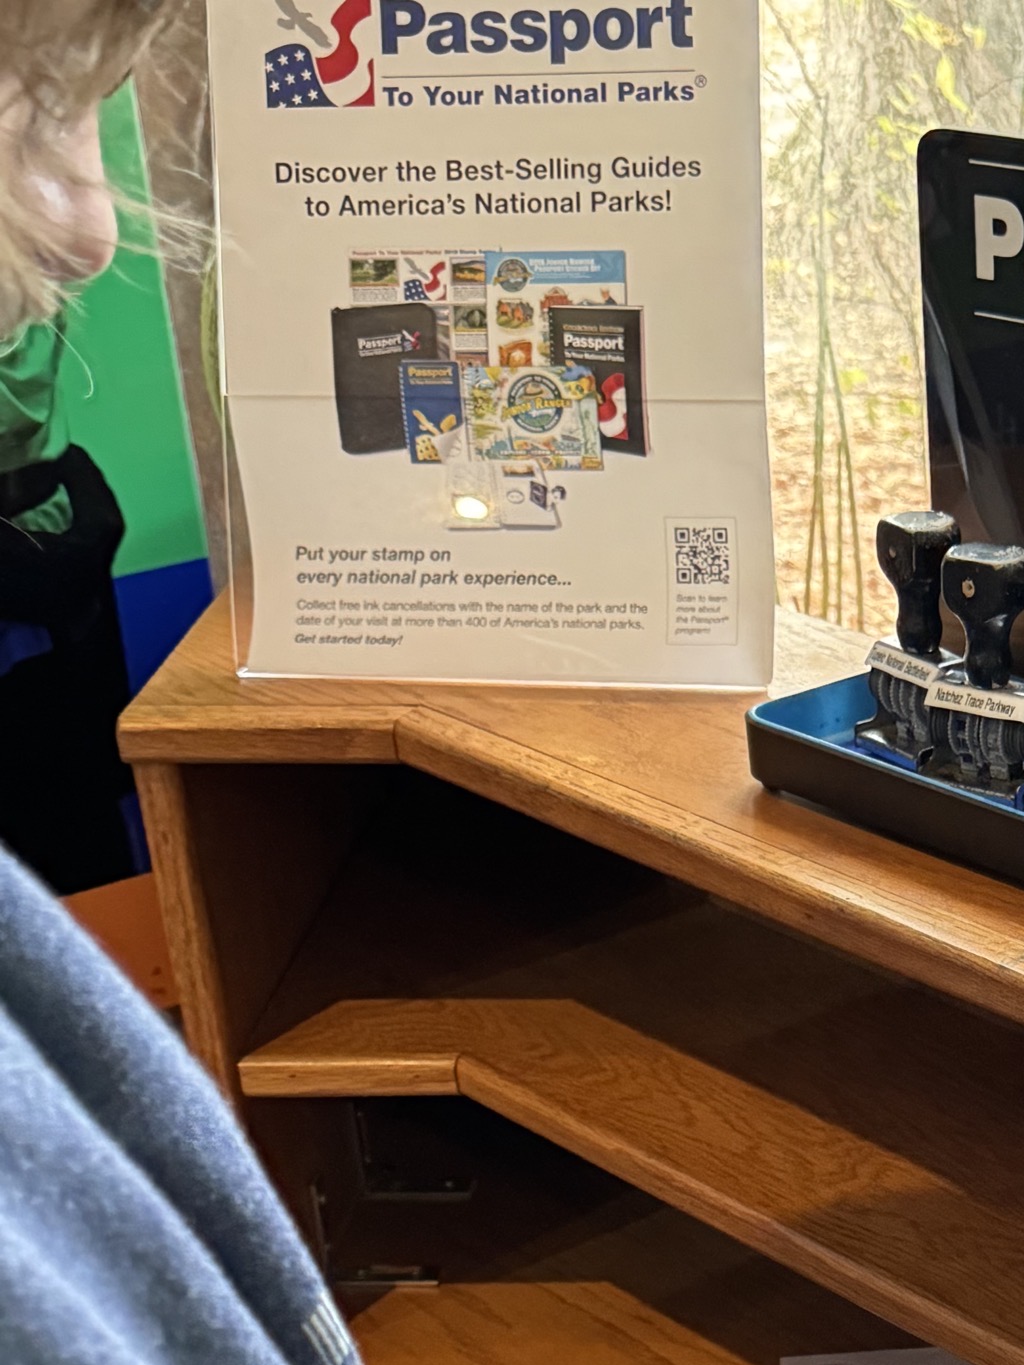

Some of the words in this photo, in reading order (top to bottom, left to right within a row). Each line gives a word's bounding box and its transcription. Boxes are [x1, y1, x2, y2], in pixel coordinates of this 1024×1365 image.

[380, 0, 694, 64] Passport
[383, 87, 413, 107] To
[423, 86, 484, 106] Your
[494, 82, 607, 105] National
[275, 161, 387, 184] Discover
[396, 161, 436, 182] the
[446, 158, 602, 184] Best-Selling
[611, 156, 702, 179] Guides
[305, 196, 329, 216] to
[339, 194, 465, 217] America's
[475, 192, 581, 215] National
[591, 189, 671, 212] Parks!
[563, 332, 624, 351] Passport
[295, 546, 324, 561] Put
[327, 548, 367, 565] your
[372, 548, 424, 564] stamp
[429, 550, 451, 562] on
[296, 572, 342, 587] every
[346, 570, 416, 585] national
[420, 571, 458, 588] park
[463, 570, 572, 588] experience...
[296, 600, 336, 611] Collect
[339, 600, 360, 611] free
[363, 601, 380, 611] ink
[382, 601, 456, 612] cancellations
[459, 602, 483, 612] with
[486, 602, 503, 612] the
[506, 604, 538, 613] name
[541, 602, 552, 613] of
[556, 603, 574, 613] the
[576, 603, 602, 616] park
[604, 603, 627, 614] and
[630, 604, 648, 614] the
[296, 615, 320, 626] date
[323, 615, 336, 626] of
[338, 617, 363, 629] your
[365, 616, 388, 626] visit
[391, 616, 402, 626] at
[405, 618, 434, 627] more
[437, 616, 462, 627] than
[465, 617, 487, 628] 400
[489, 617, 501, 627] of
[562, 618, 607, 629] national
[609, 618, 645, 631] parks.
[294, 634, 316, 645] Get
[318, 634, 363, 645] started
[364, 634, 403, 647] today!
[934, 687, 962, 706] Natchez
[964, 692, 984, 709] Trace
[984, 697, 1016, 718] Parkway
